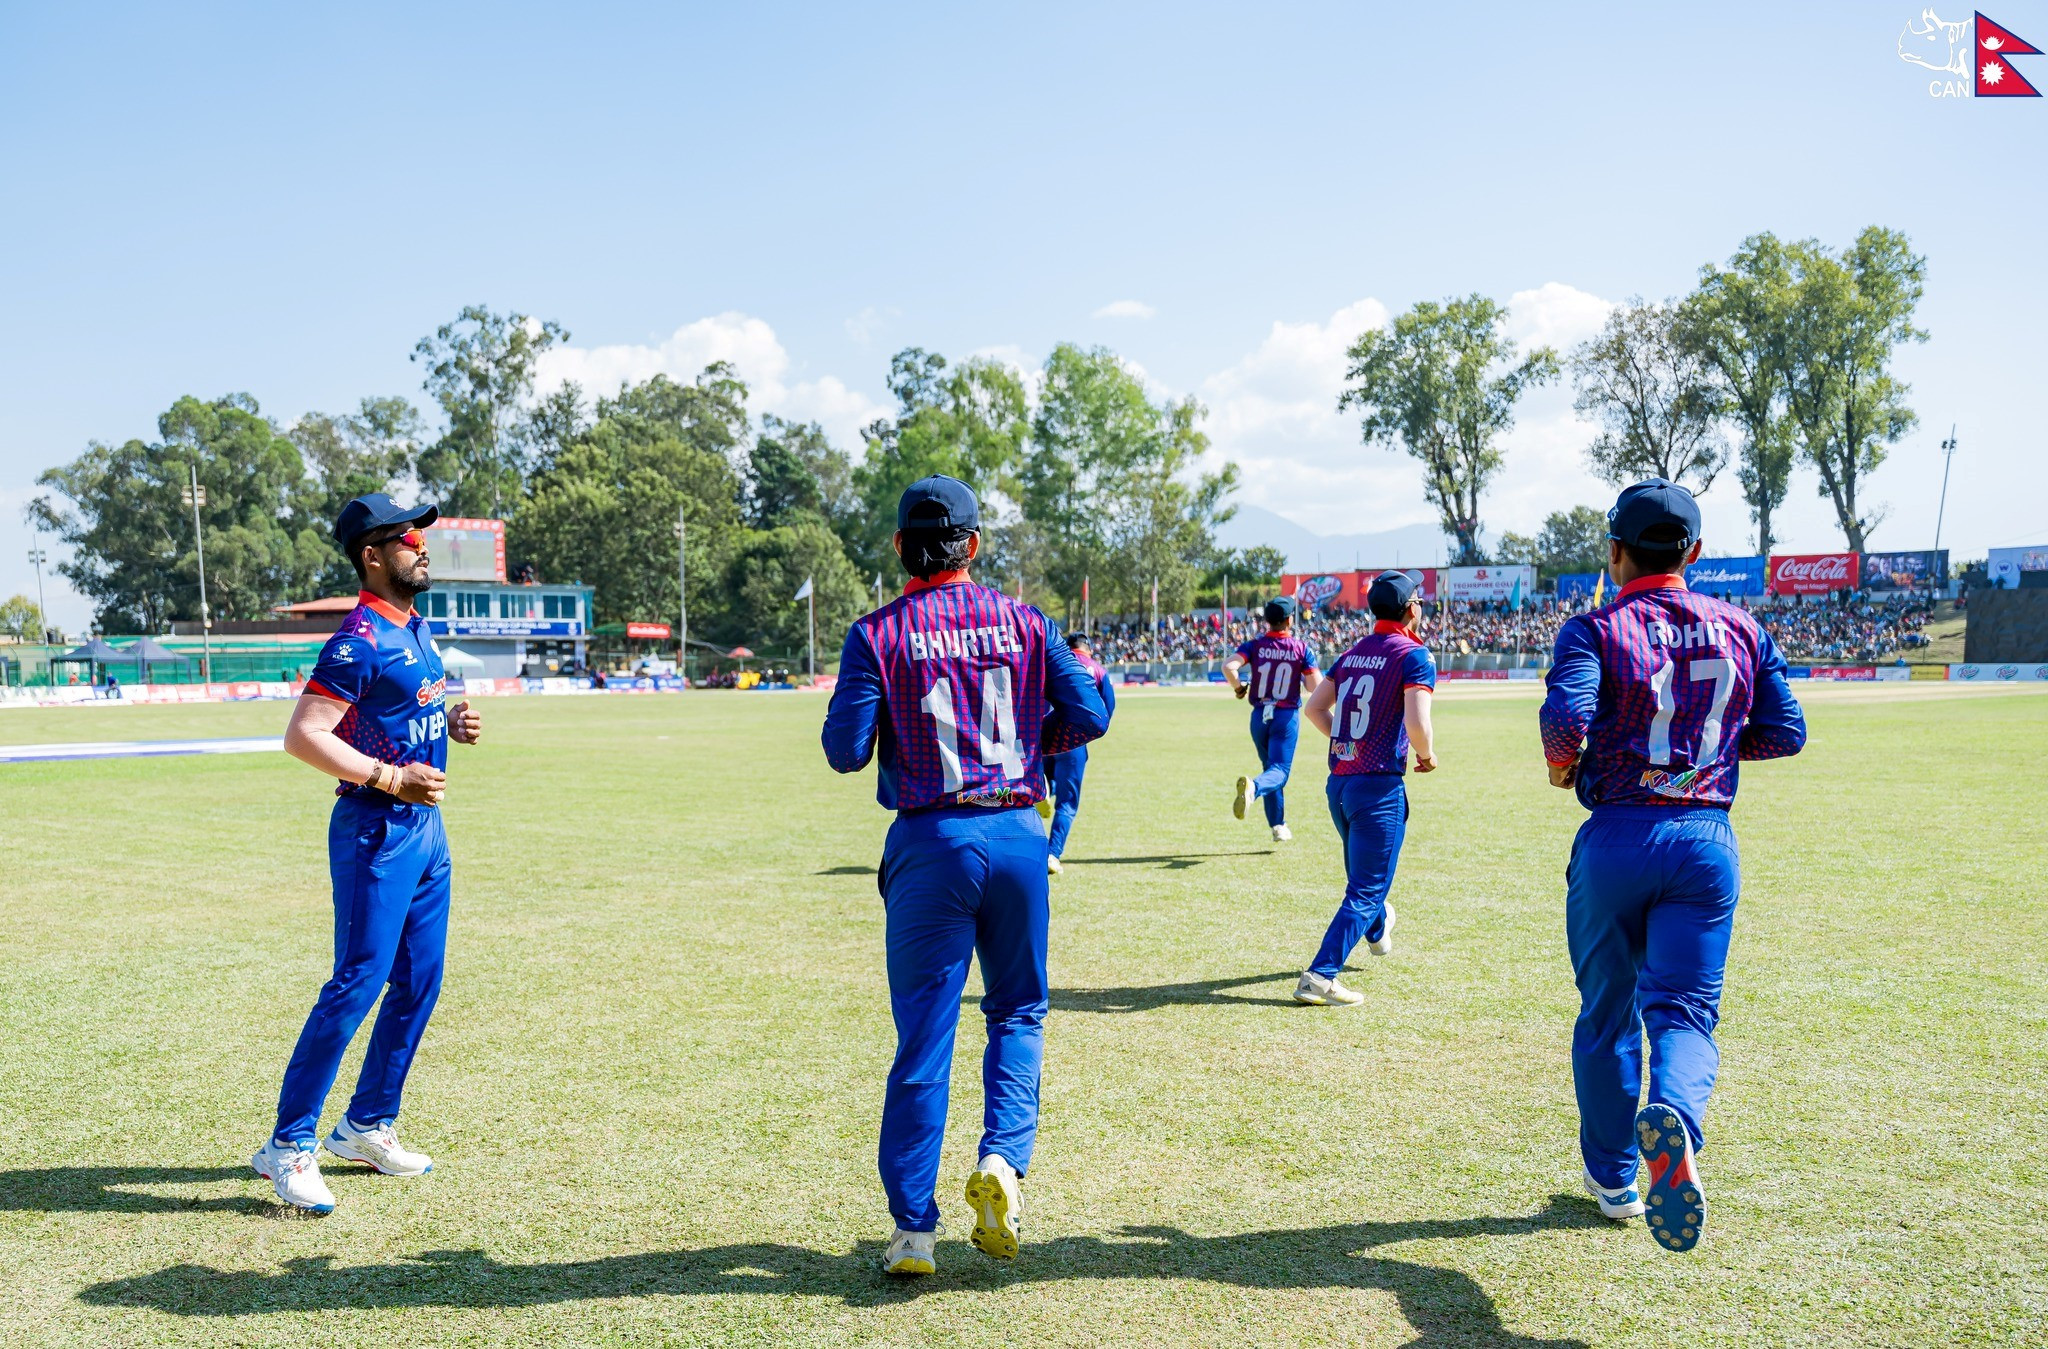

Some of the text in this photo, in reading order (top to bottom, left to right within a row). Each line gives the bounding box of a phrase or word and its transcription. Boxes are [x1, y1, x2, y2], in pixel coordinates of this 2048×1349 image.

[1777, 556, 1851, 581] Coca-Cola
[1302, 580, 1338, 603] Real
[1495, 580, 1528, 588] COLLE
[909, 625, 1023, 660] BHURTEL
[1647, 621, 1729, 649] ROHIT
[332, 653, 354, 663] KELME
[1258, 647, 1297, 661] SOMPAL
[1341, 655, 1387, 670] AVINASH
[1257, 661, 1293, 700] 10
[1330, 674, 1375, 740] 13
[1648, 658, 1738, 769] 17
[408, 711, 448, 744] NEP
[920, 666, 1027, 793] 14
